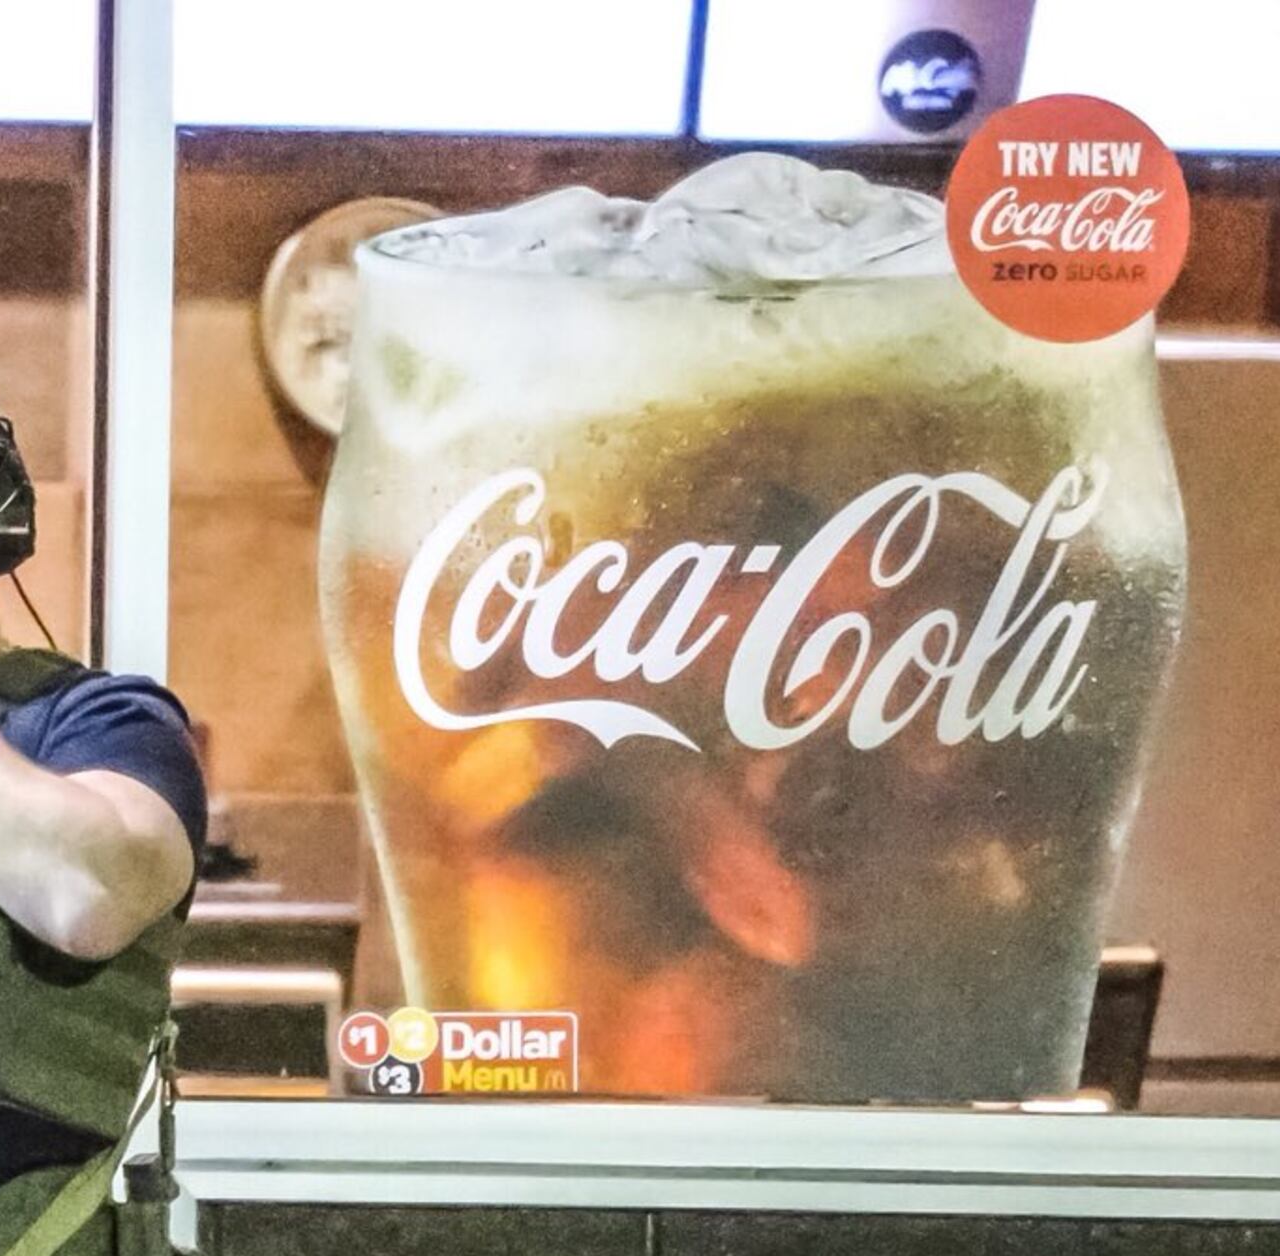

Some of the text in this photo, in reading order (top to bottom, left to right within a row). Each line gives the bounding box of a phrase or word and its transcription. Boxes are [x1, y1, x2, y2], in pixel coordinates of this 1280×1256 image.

[998, 141, 1142, 177] TRY NEW
[970, 186, 1166, 253] Coca-Cola
[992, 259, 1147, 282] zero SUGAR
[393, 460, 1109, 752] Coca-Cola
[441, 1020, 567, 1061] Dollar
[442, 1060, 538, 1092] Menu
